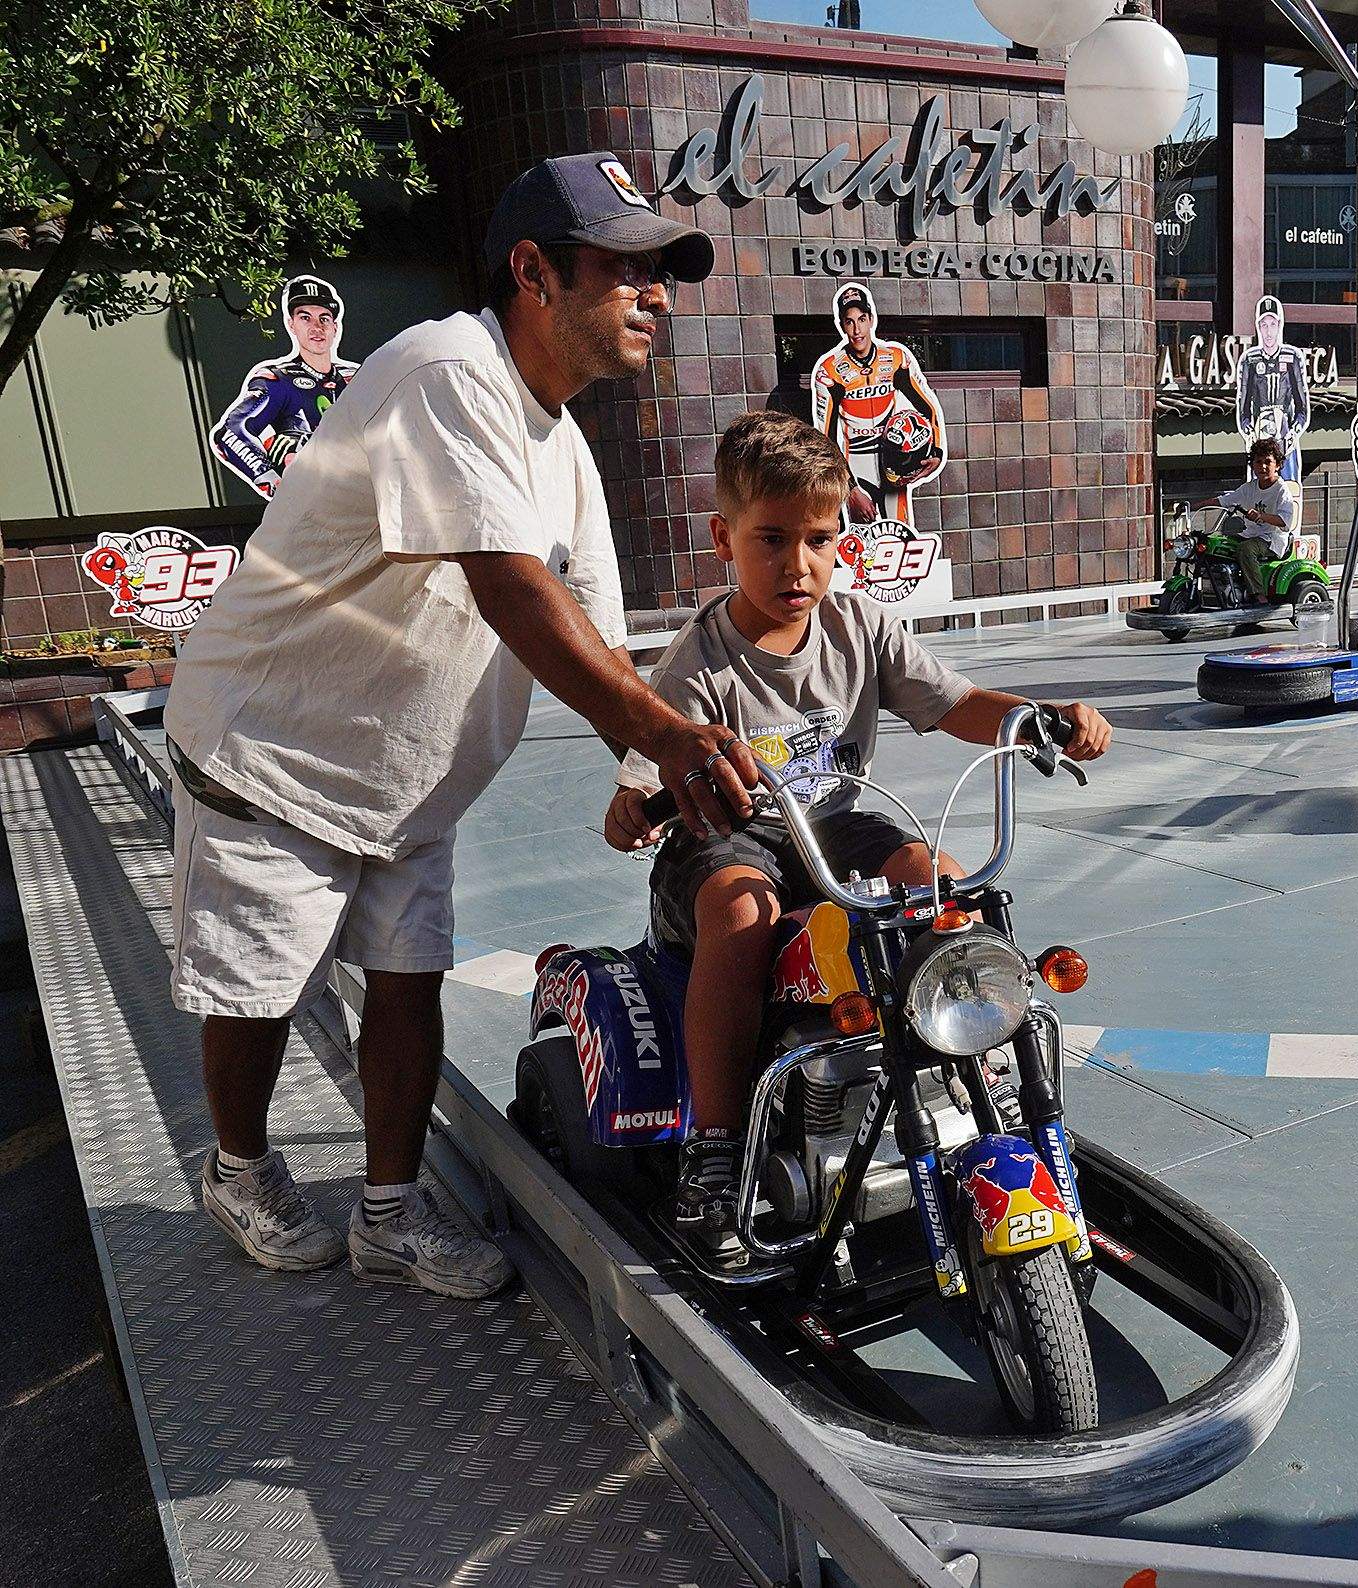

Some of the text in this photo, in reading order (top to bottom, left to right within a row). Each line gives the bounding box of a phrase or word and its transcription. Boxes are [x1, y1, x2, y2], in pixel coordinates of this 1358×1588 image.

[661, 74, 1122, 239] el cafetin
[1285, 228, 1344, 245] el cafetin
[220, 429, 264, 477] YAMAHA
[135, 530, 183, 551] MARC
[871, 523, 903, 537] MARC
[138, 549, 238, 604] 93
[869, 538, 937, 583] 93
[749, 722, 801, 736] DISPATCH
[808, 713, 838, 725] ORDER
[603, 962, 662, 1070] SUZUKI
[613, 1109, 677, 1130] MOTUL
[704, 1127, 728, 1138] MARVEL
[1045, 1127, 1078, 1214] MICHELIN
[915, 1160, 947, 1248] MICHELIN
[1007, 1208, 1056, 1247] 29
